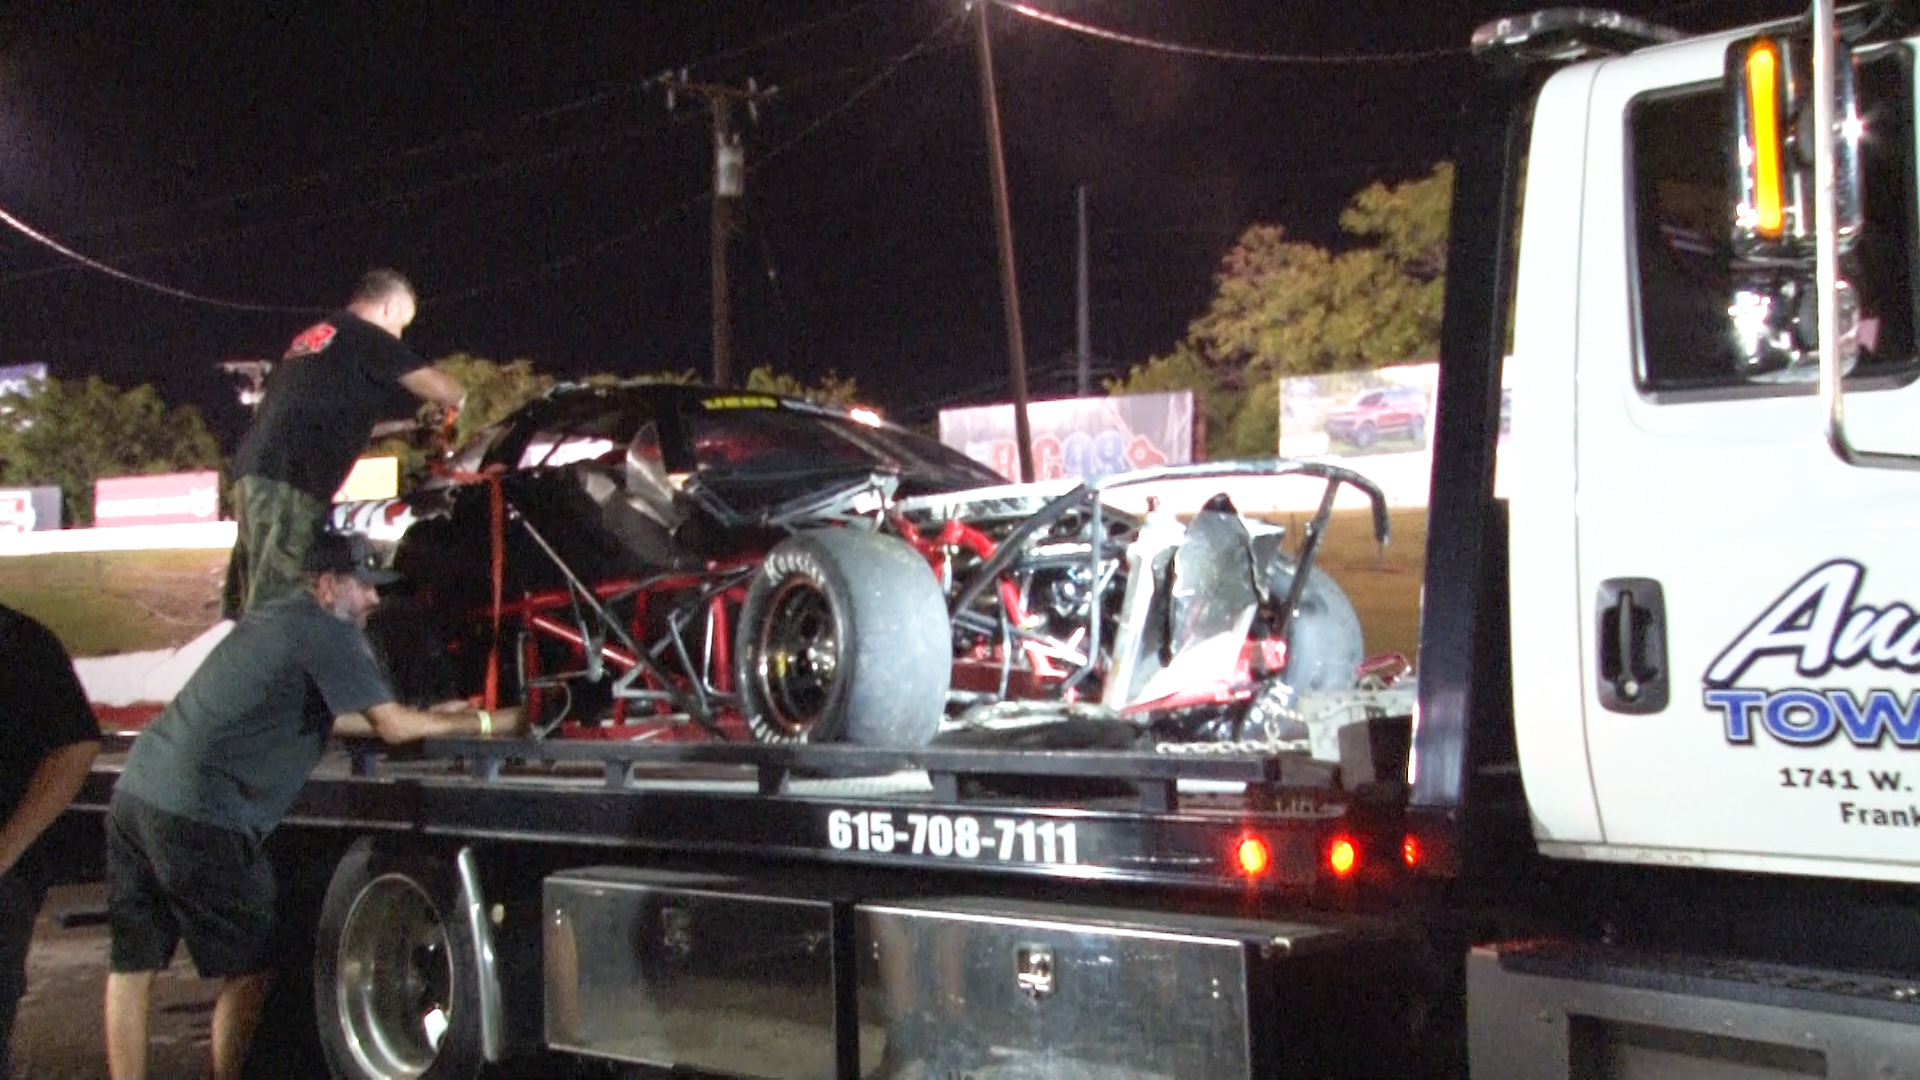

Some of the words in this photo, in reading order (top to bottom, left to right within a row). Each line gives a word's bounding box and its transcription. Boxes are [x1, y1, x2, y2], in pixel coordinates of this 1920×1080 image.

[1779, 767, 1860, 790] 1741
[1868, 770, 1913, 792] W.
[828, 809, 1077, 864] 615-708-7111
